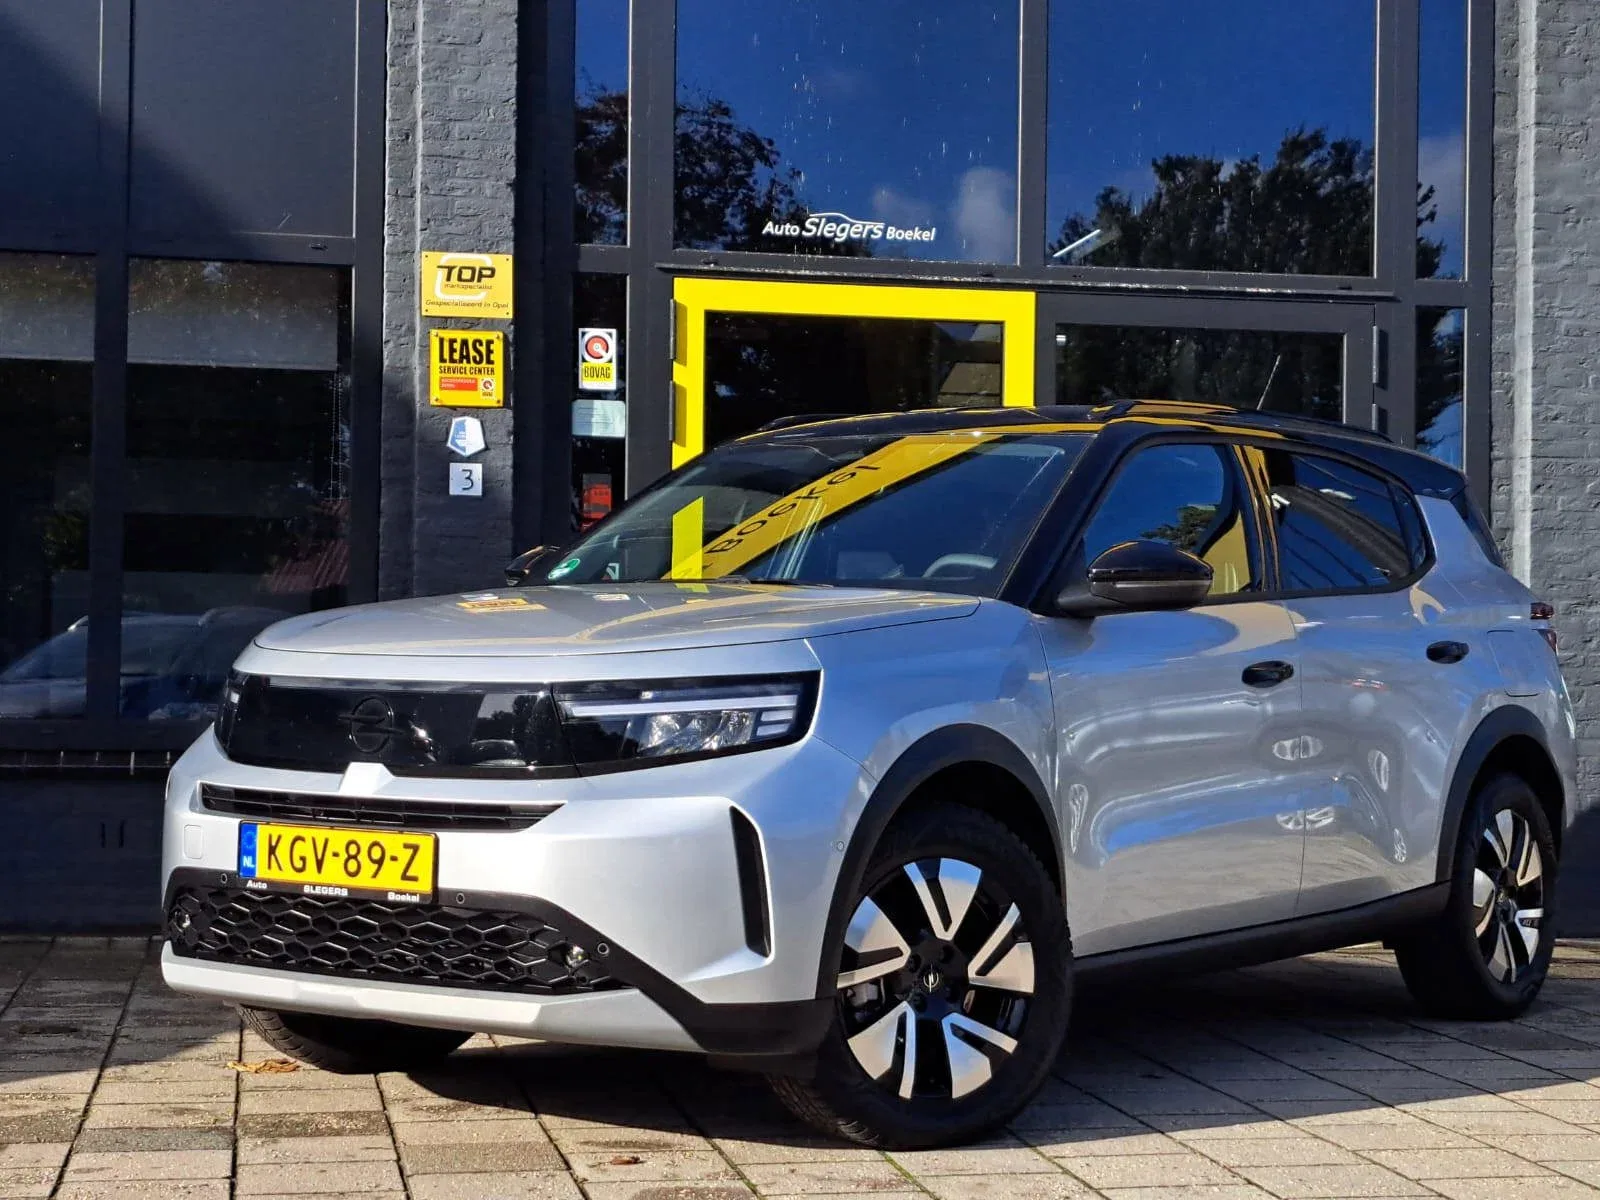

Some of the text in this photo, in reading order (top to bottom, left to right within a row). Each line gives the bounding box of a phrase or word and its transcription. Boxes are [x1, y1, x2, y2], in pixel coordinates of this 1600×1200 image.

[762, 217, 936, 243] Auto Slegers Boekel
[437, 265, 496, 283] TOP
[439, 336, 495, 365] LEASE
[439, 365, 495, 376] SERVICE CENTER
[584, 366, 611, 379] BOVAG
[462, 469, 474, 490] 3
[243, 856, 254, 868] NL
[267, 833, 420, 882] KGV-89-Z
[246, 879, 420, 903] Auto SLEGERS Boekel
